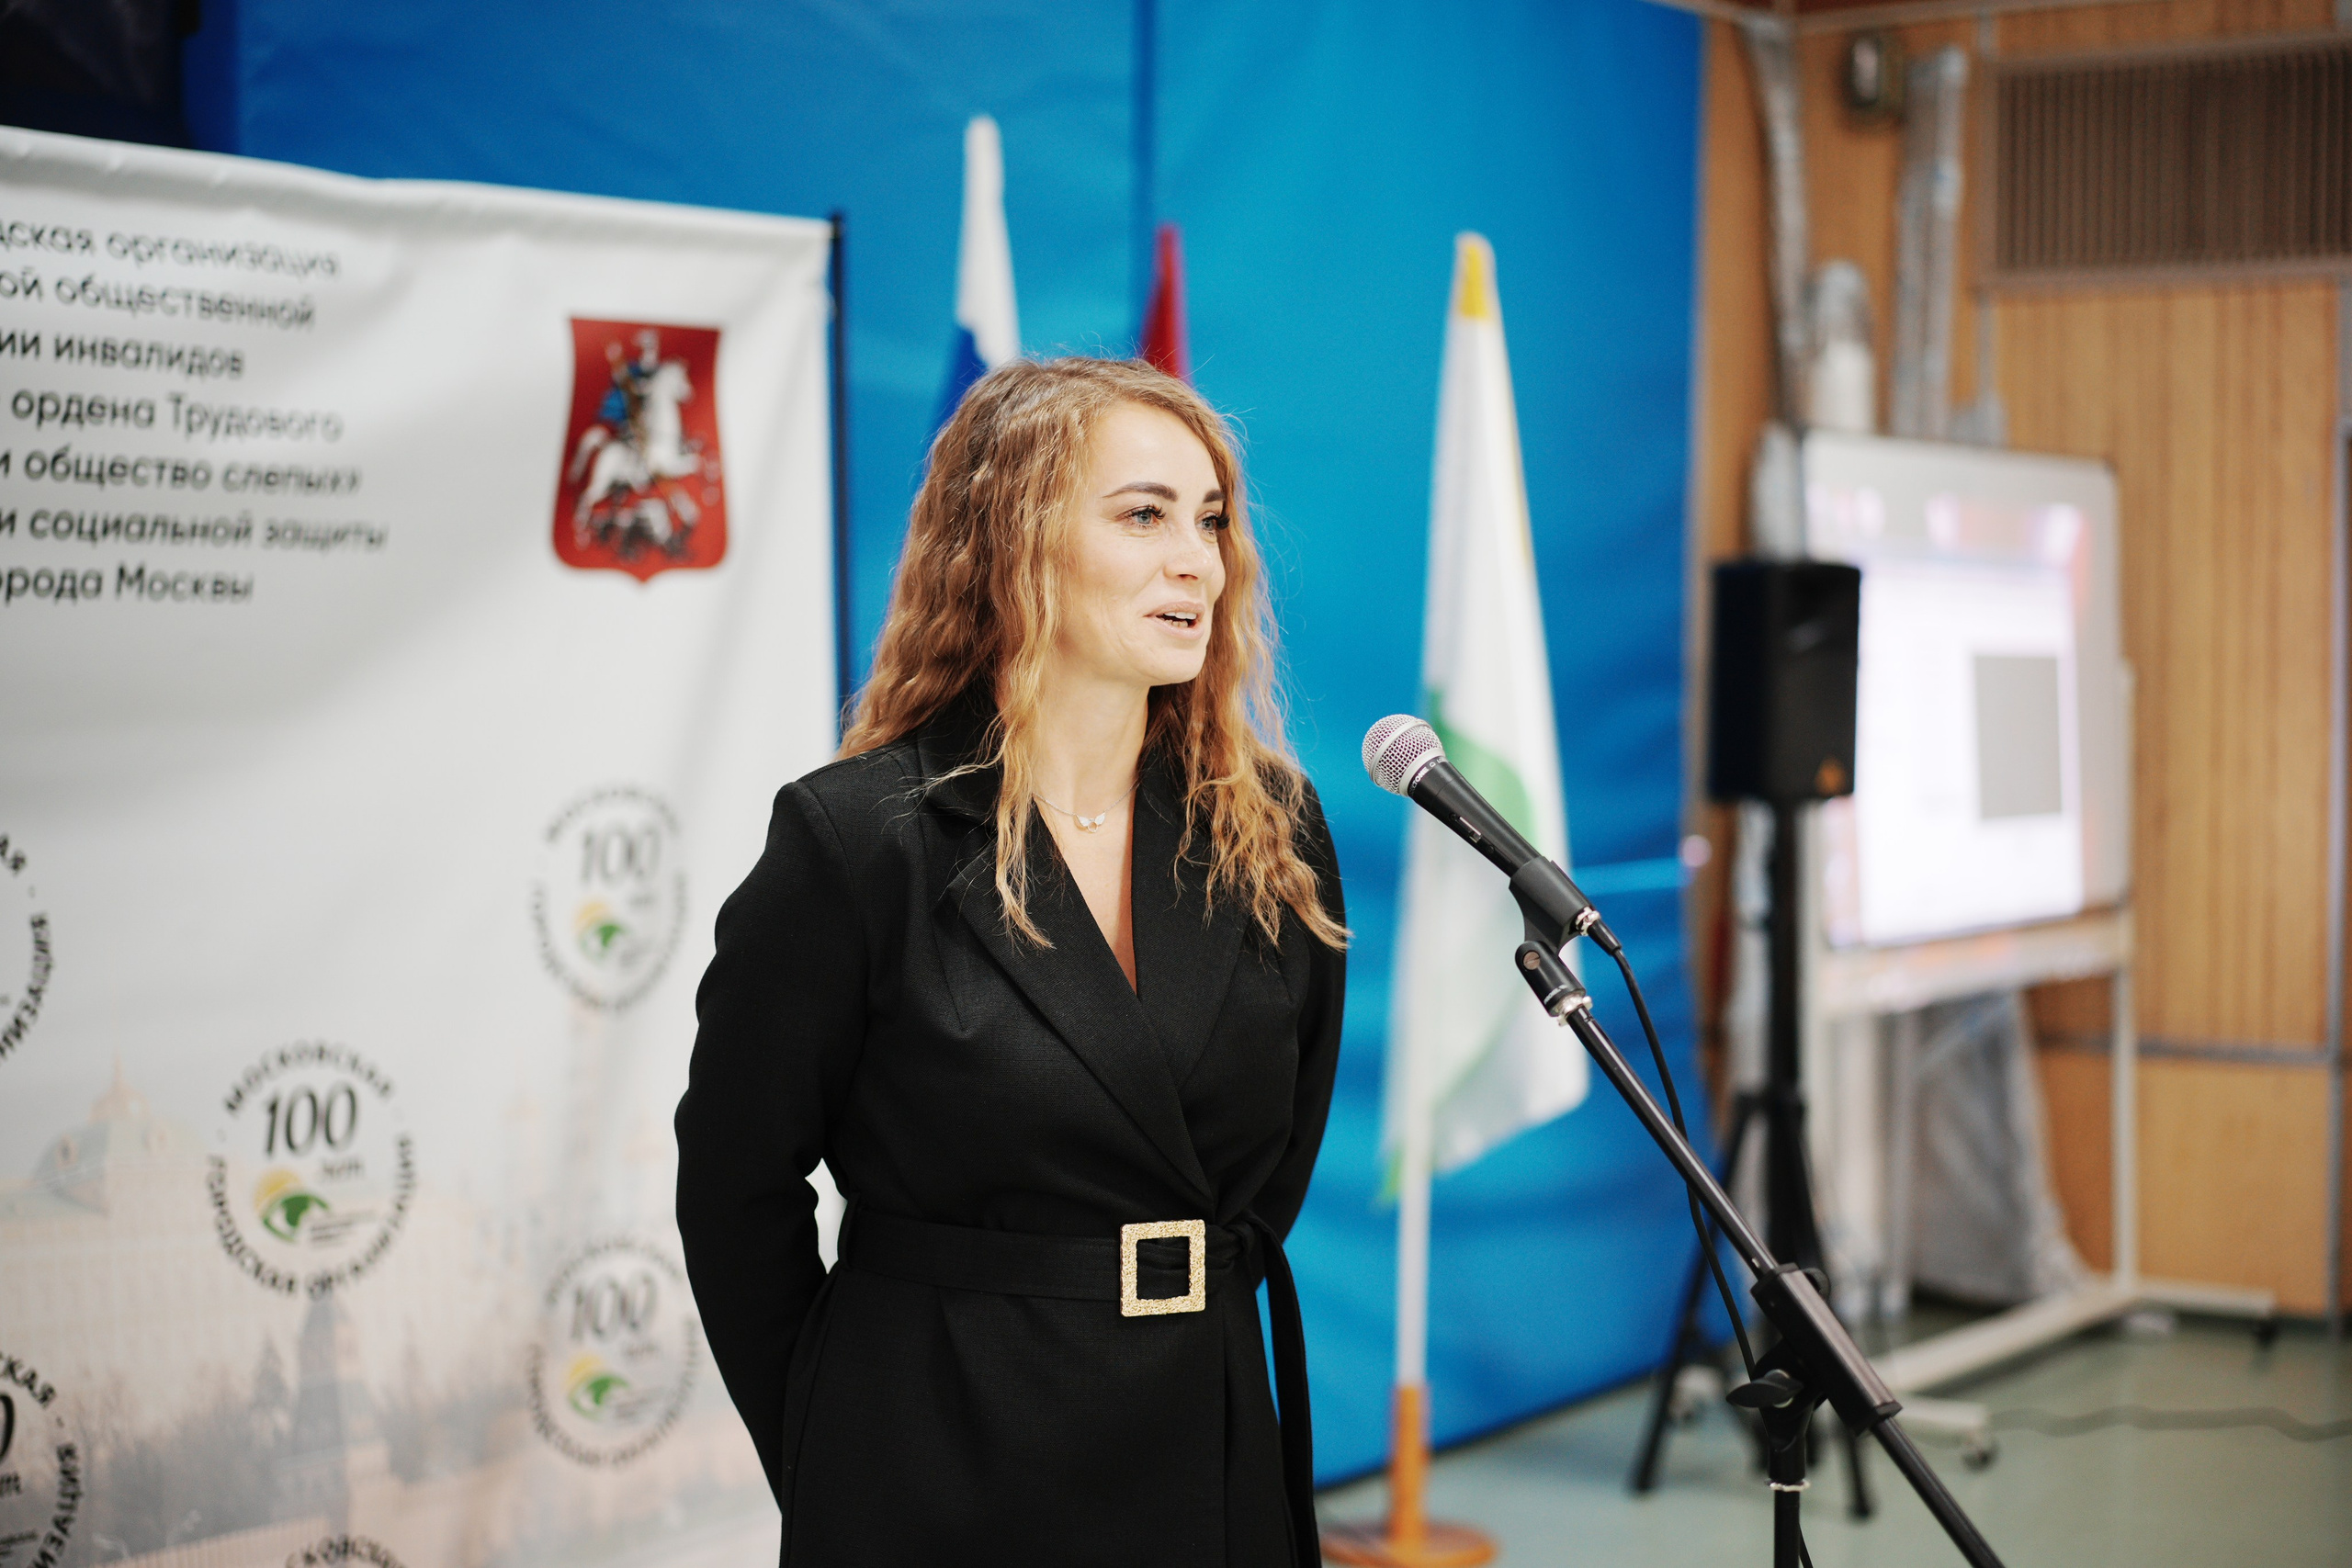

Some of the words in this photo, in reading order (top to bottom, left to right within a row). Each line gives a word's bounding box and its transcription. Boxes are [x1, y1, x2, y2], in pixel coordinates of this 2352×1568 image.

[107, 231, 341, 278] организация
[54, 273, 317, 331] общественной
[54, 333, 245, 380] инвалидов
[11, 389, 156, 429] ордена
[168, 391, 345, 443] Трудового
[24, 442, 212, 491] общество
[28, 508, 254, 548] социальной
[263, 517, 389, 556] защиты
[0, 565, 103, 606] рода
[115, 560, 255, 604] Москвы
[264, 1080, 357, 1158] 100
